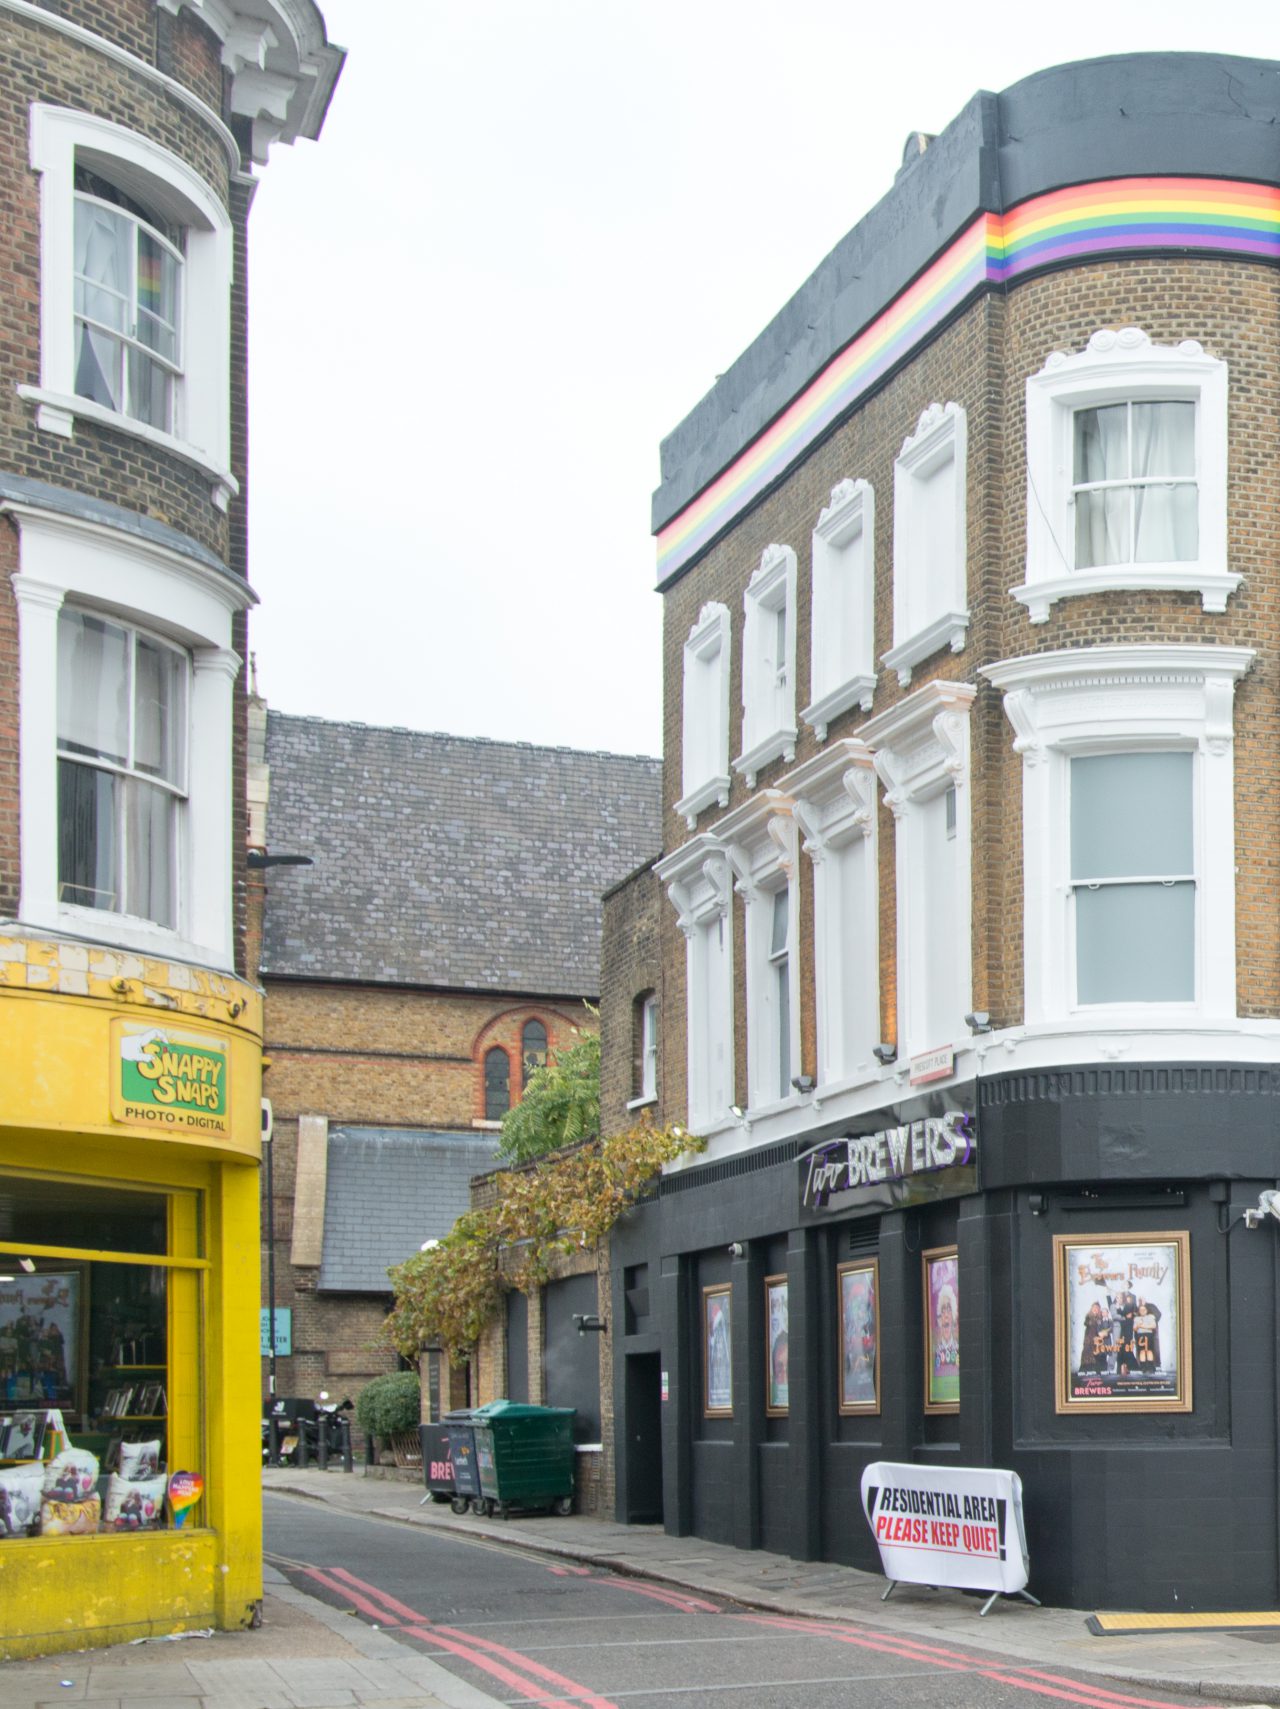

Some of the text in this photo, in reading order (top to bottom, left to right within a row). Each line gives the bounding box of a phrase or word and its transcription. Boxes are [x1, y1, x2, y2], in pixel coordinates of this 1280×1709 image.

[136, 1042, 222, 1086] SNAPPY
[152, 1075, 219, 1111] SNAPS
[125, 1107, 226, 1132] PHOTO DIGITAL
[793, 1111, 970, 1207] Two BREWERS
[1128, 1261, 1168, 1286] Family
[1074, 1386, 1112, 1395] BREWERS
[880, 1487, 962, 1519] RESIDENTIAL
[963, 1494, 997, 1523] AREA
[876, 1515, 998, 1553] PLEASE KEEP QUIET
